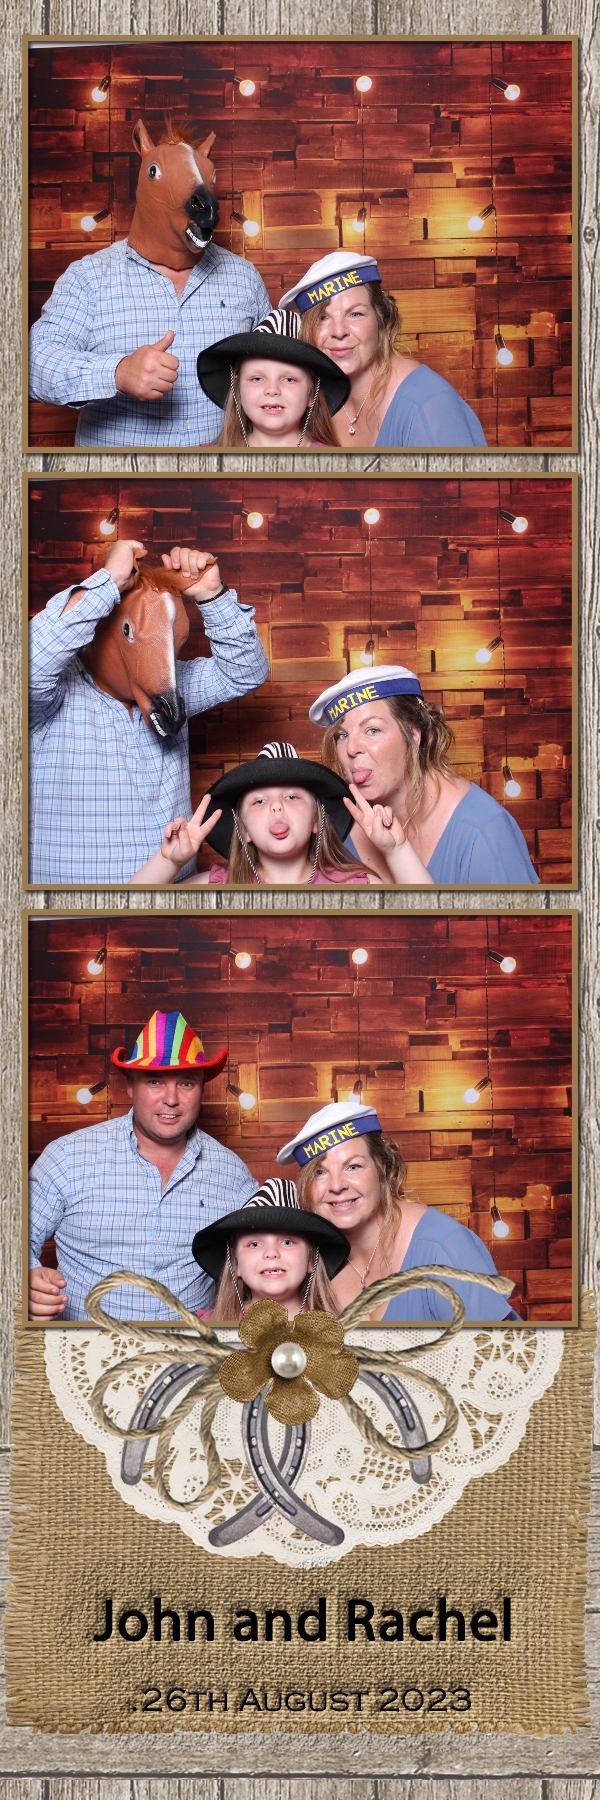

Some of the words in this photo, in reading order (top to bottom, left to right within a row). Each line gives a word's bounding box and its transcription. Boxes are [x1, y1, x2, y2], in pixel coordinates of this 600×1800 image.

[307, 270, 363, 305] MARINE
[327, 685, 380, 721] MARINE
[303, 1121, 360, 1159] MARINE
